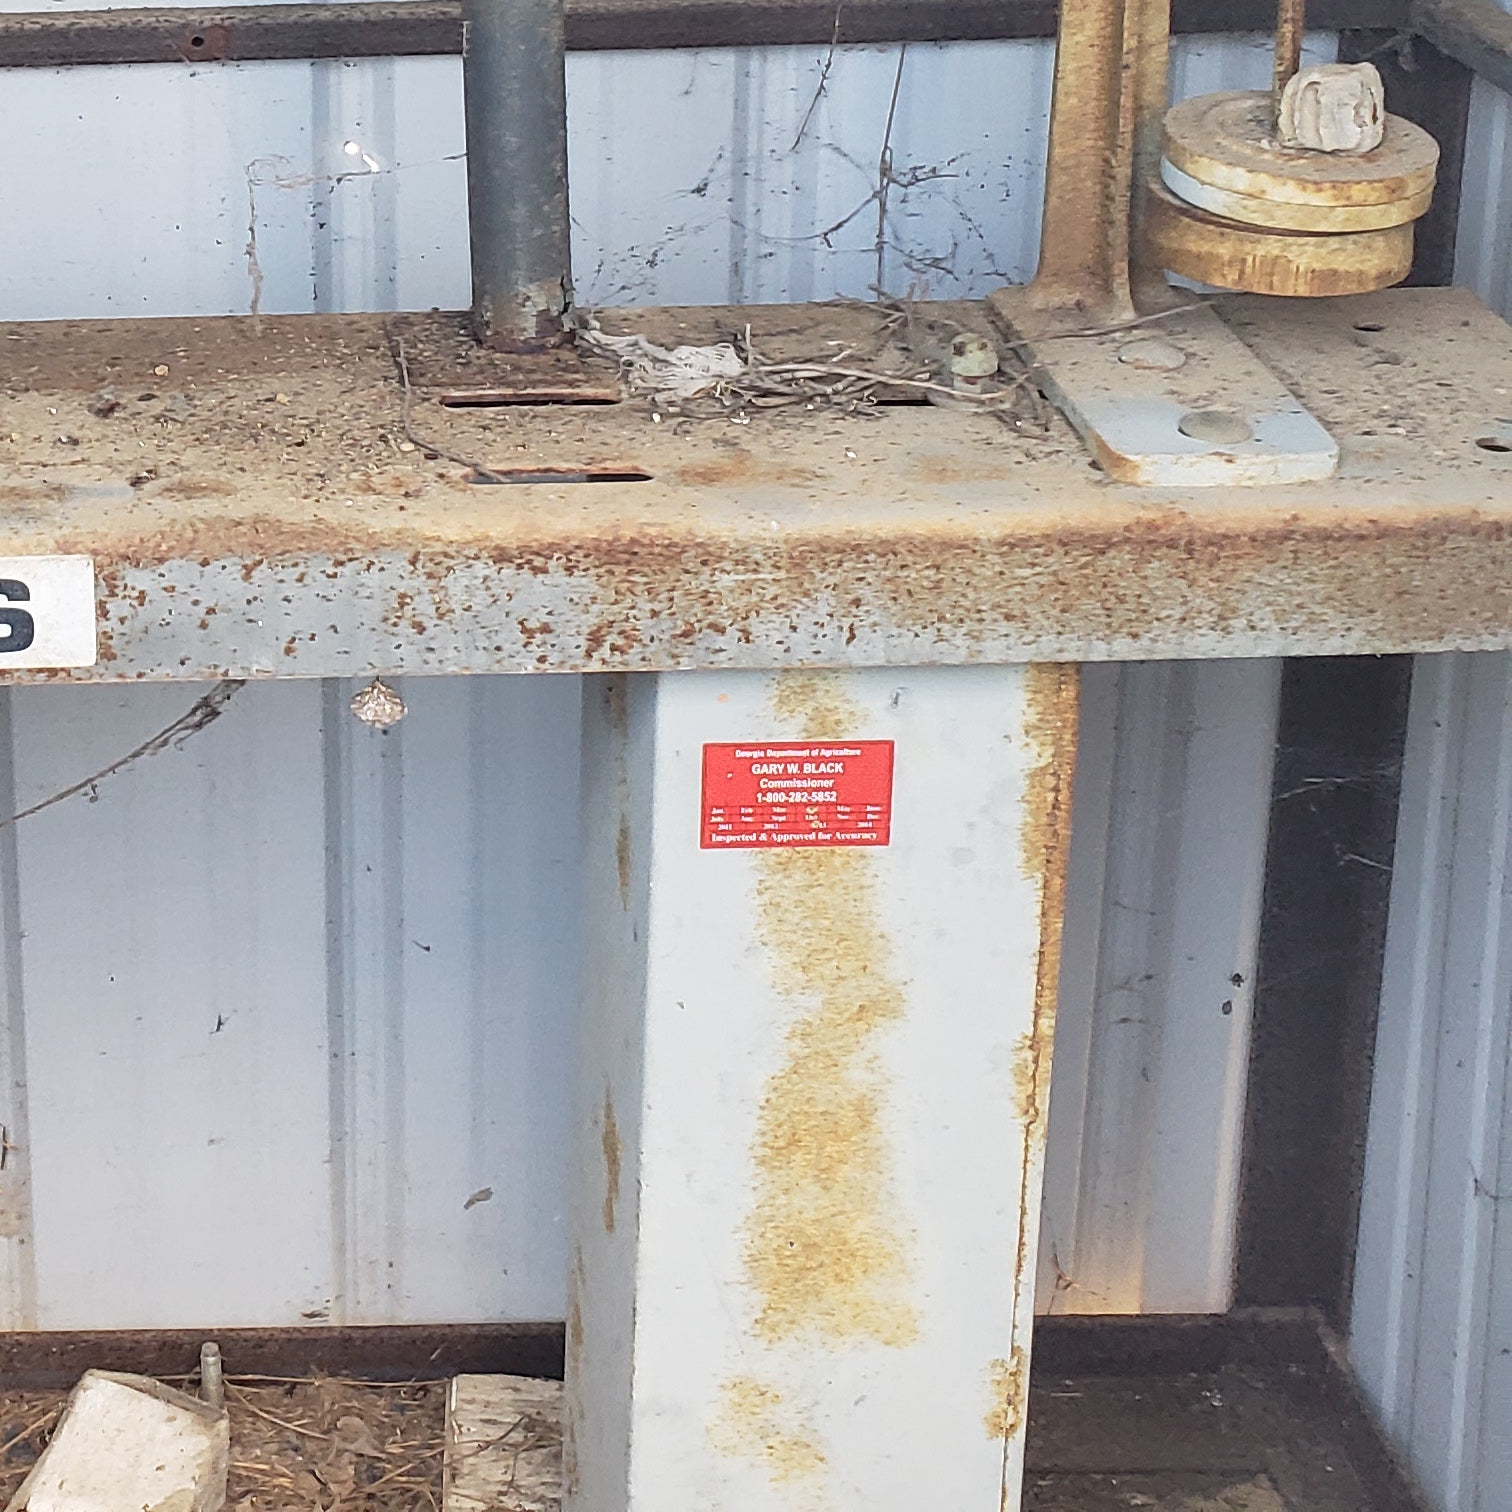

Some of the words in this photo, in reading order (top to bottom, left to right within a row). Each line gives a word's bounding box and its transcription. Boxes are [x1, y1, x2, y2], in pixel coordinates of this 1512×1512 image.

[735, 749, 765, 758] Georgia
[766, 748, 810, 758] Department
[811, 748, 819, 756] of
[820, 747, 862, 757] Agriculture
[751, 763, 784, 774] GARY
[786, 763, 800, 774] W.
[803, 762, 844, 773] BLACK
[759, 777, 835, 788] Commissioner
[756, 791, 837, 803] 1-800-282-5852
[711, 833, 757, 843] Inspected
[758, 833, 767, 841] &
[772, 832, 816, 843] Approved
[817, 831, 832, 840] for
